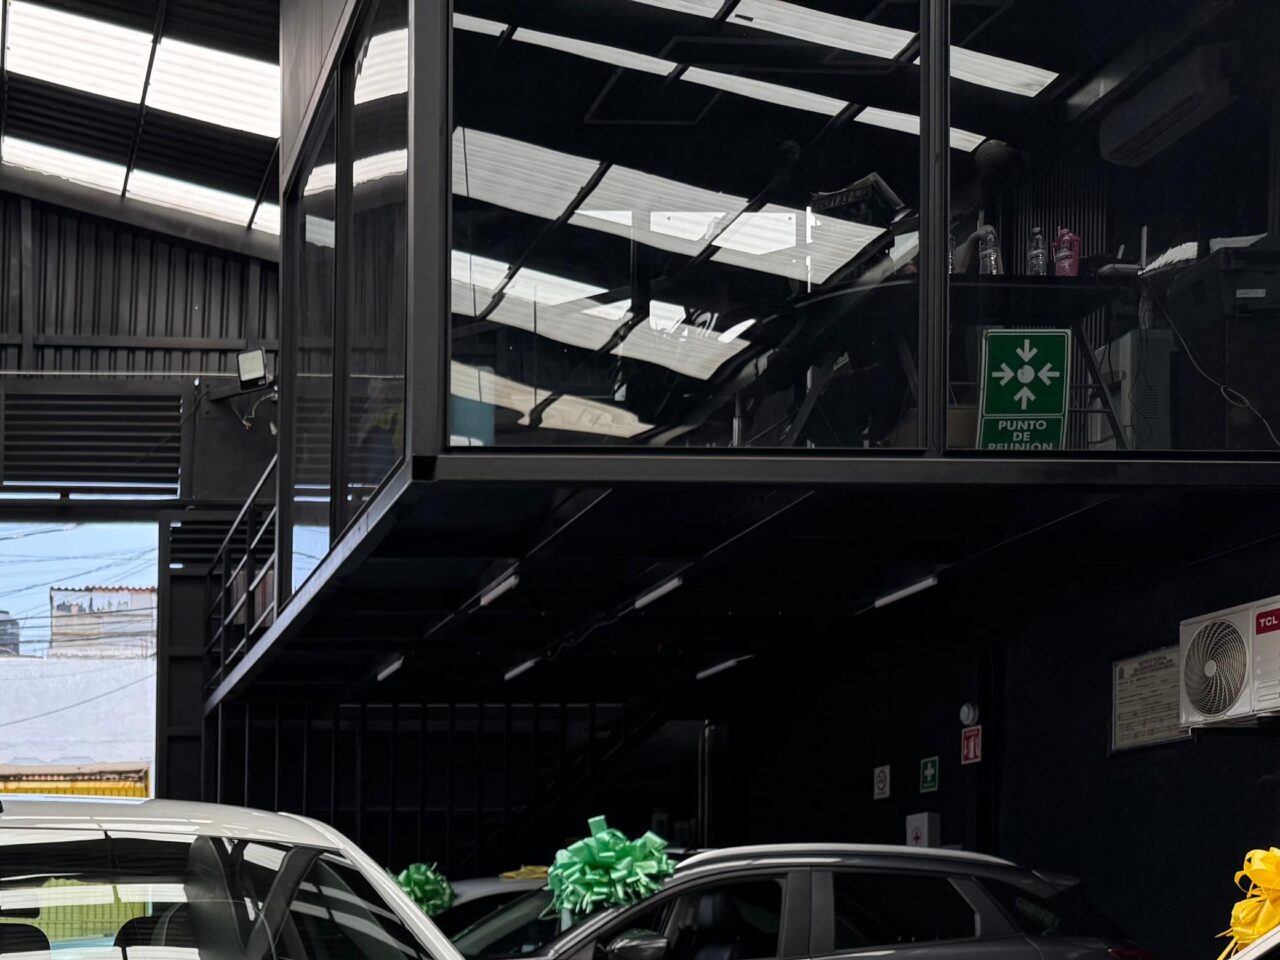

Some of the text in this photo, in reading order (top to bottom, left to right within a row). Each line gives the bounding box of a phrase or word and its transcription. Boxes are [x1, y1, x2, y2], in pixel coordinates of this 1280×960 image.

[998, 420, 1047, 430] PUNTO
[1012, 431, 1031, 441] DE
[1259, 616, 1278, 627] TCL
